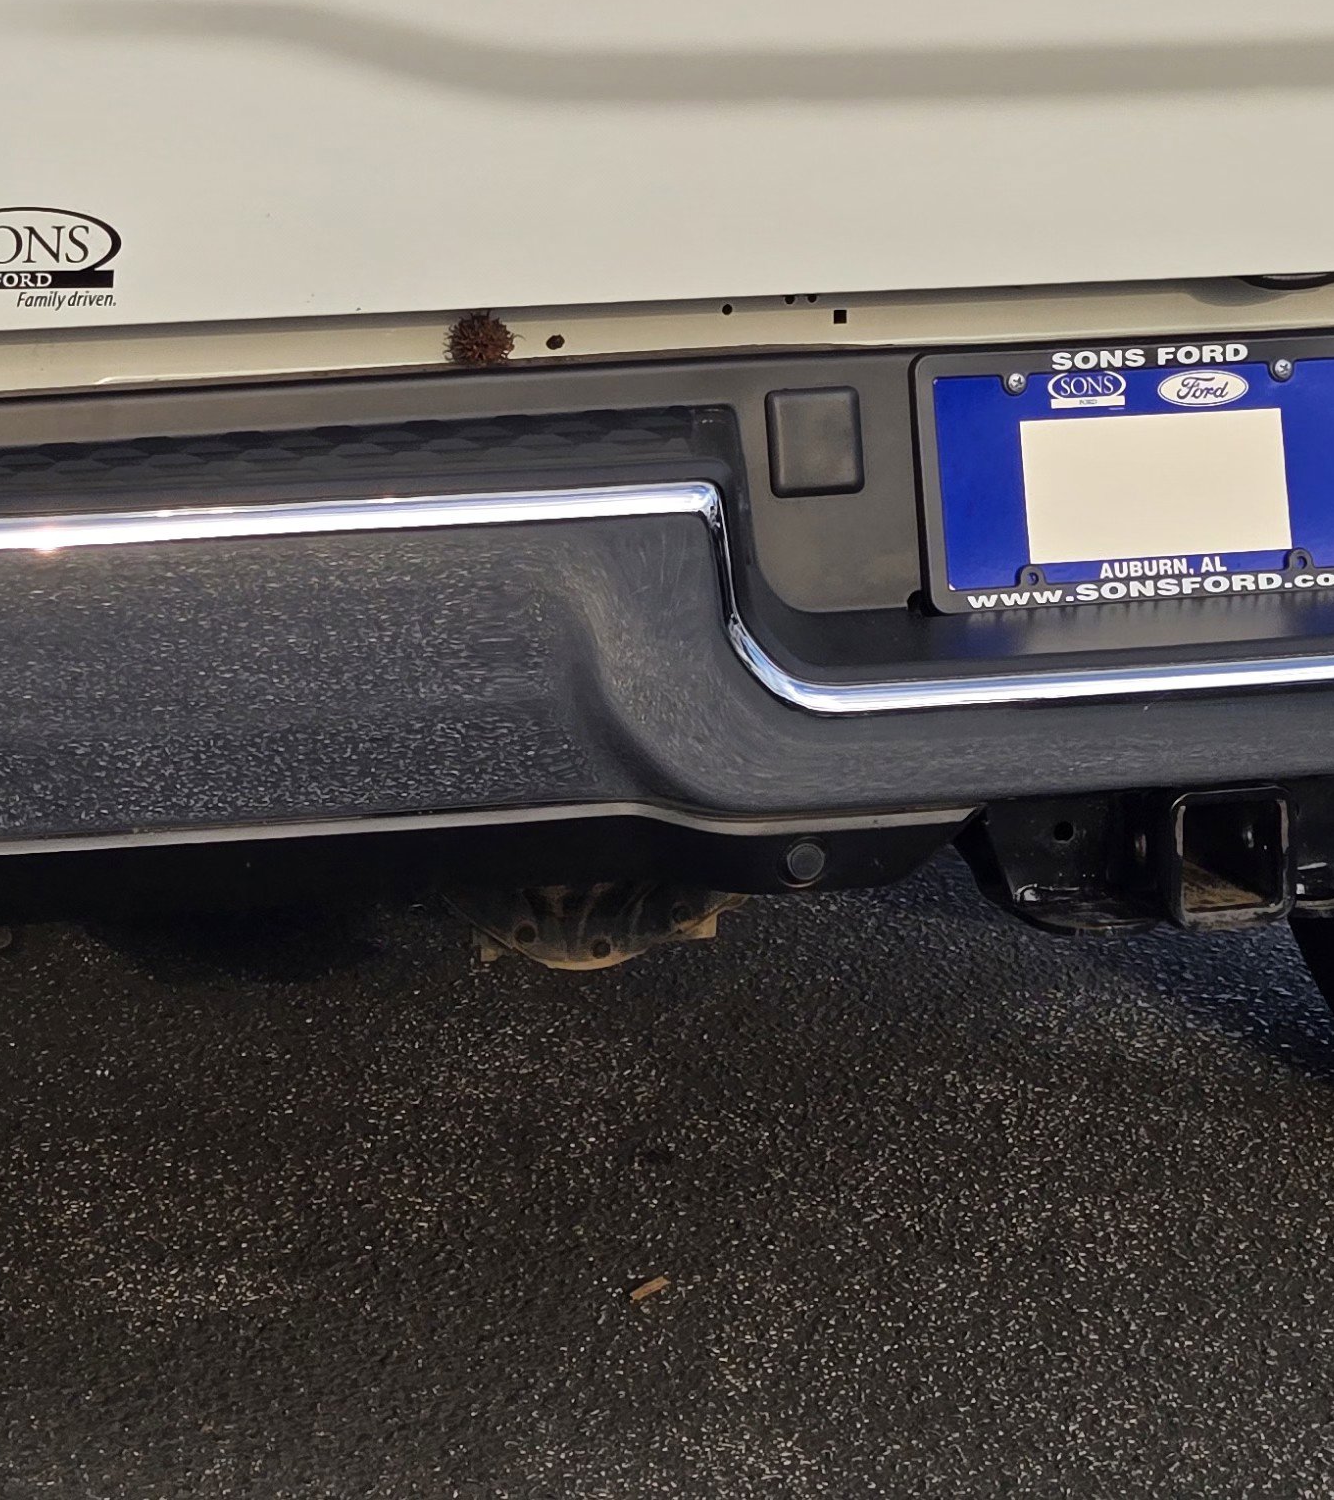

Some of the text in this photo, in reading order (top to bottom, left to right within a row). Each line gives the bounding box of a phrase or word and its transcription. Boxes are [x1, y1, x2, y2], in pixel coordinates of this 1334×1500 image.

[16, 290, 117, 312] Family driven.
[1051, 343, 1249, 371] SONS FORD
[1060, 375, 1115, 396] SONS
[1176, 376, 1229, 400] Ford
[1099, 555, 1228, 580] AUBURN, AL
